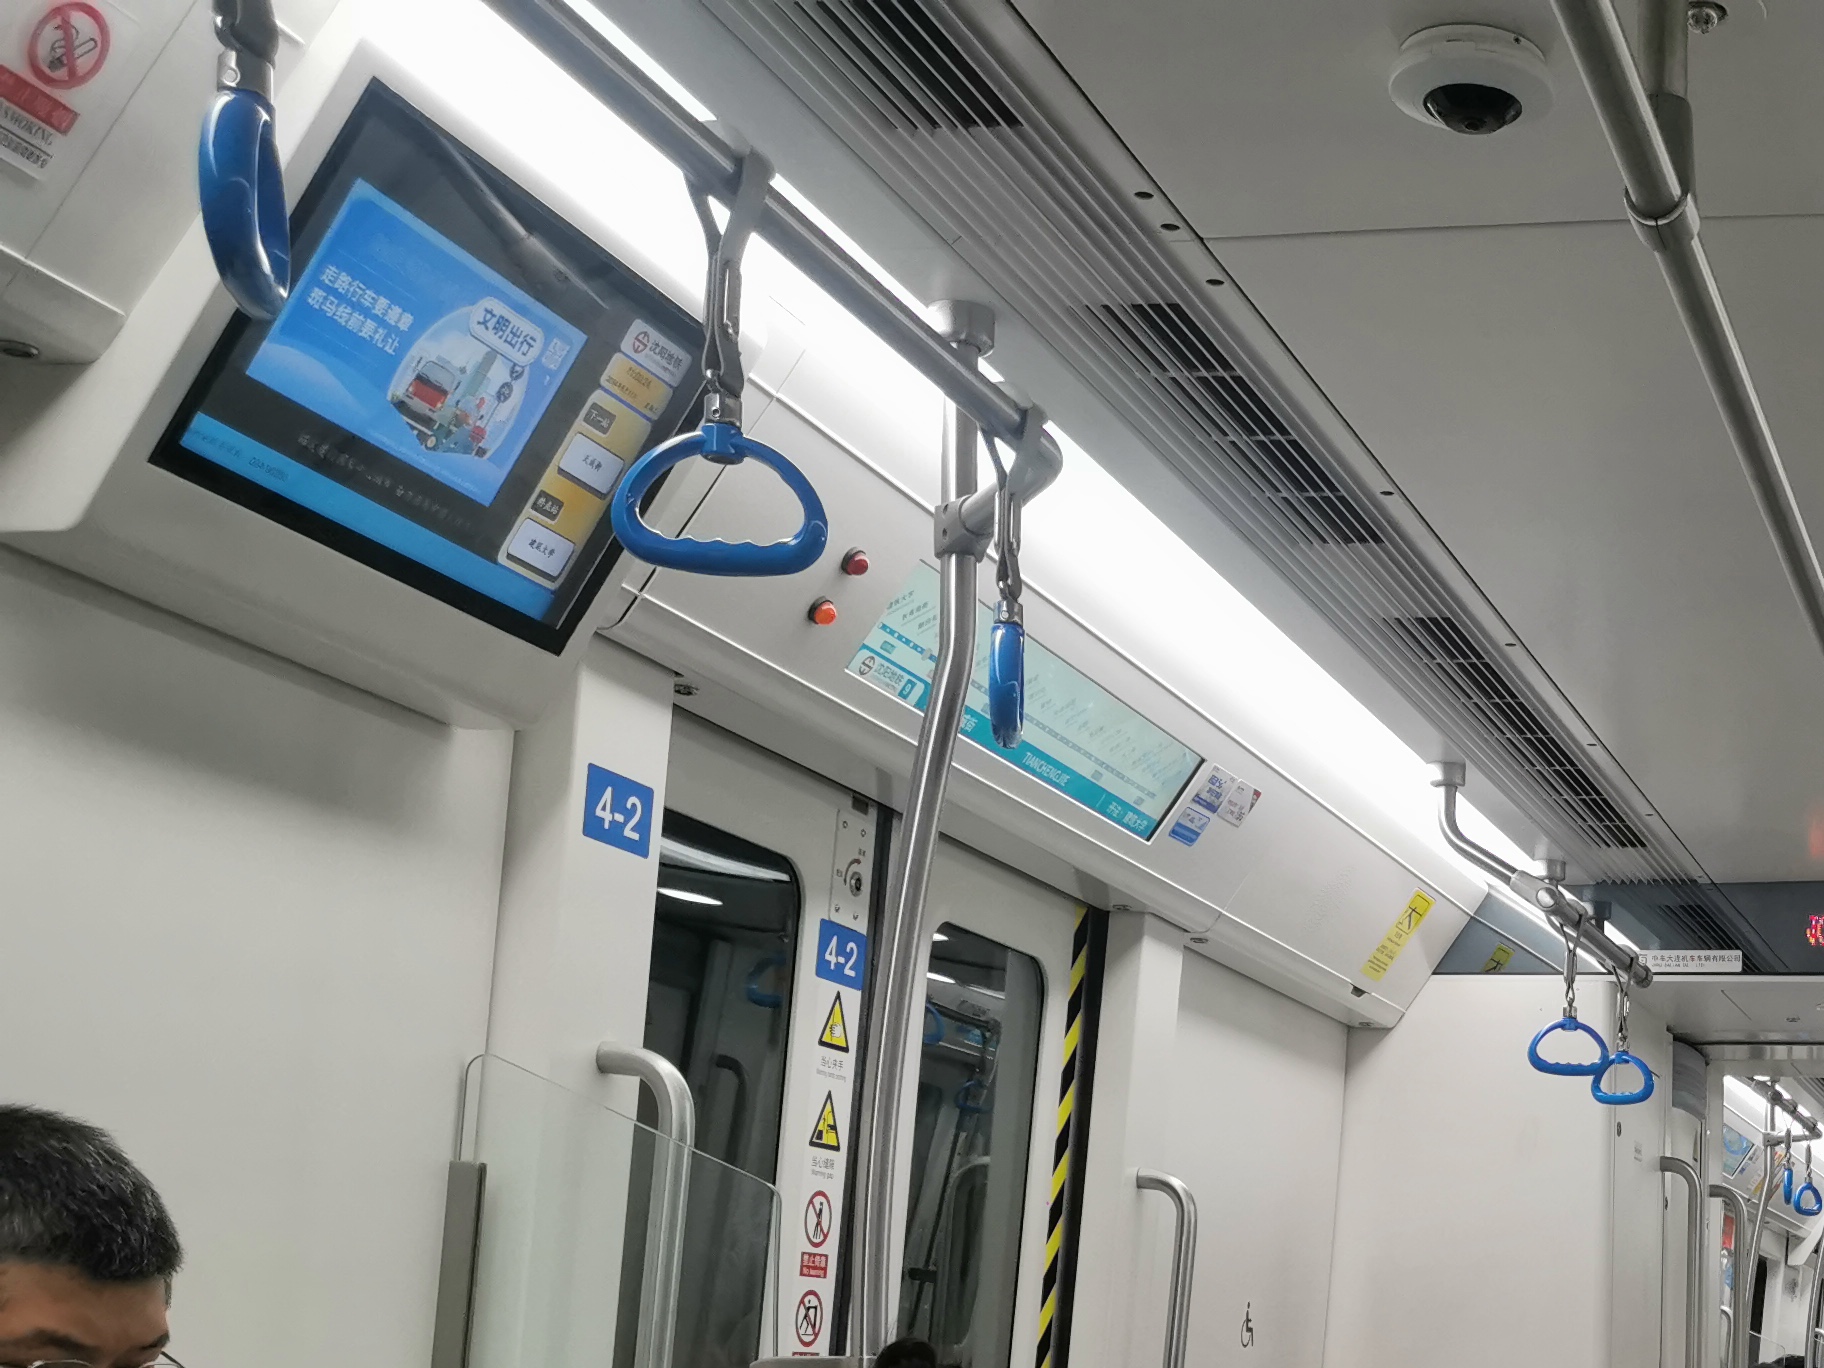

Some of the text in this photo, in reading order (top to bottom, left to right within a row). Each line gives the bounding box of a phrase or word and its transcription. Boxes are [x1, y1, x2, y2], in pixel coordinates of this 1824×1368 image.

[477, 307, 538, 357] 文明出行
[649, 339, 685, 371] 沈阳地铁
[587, 409, 609, 428] 下一站
[902, 682, 913, 697] 9
[595, 786, 642, 841] 4-2
[824, 935, 858, 978] 4-2
[821, 1056, 844, 1071] 当心夹手
